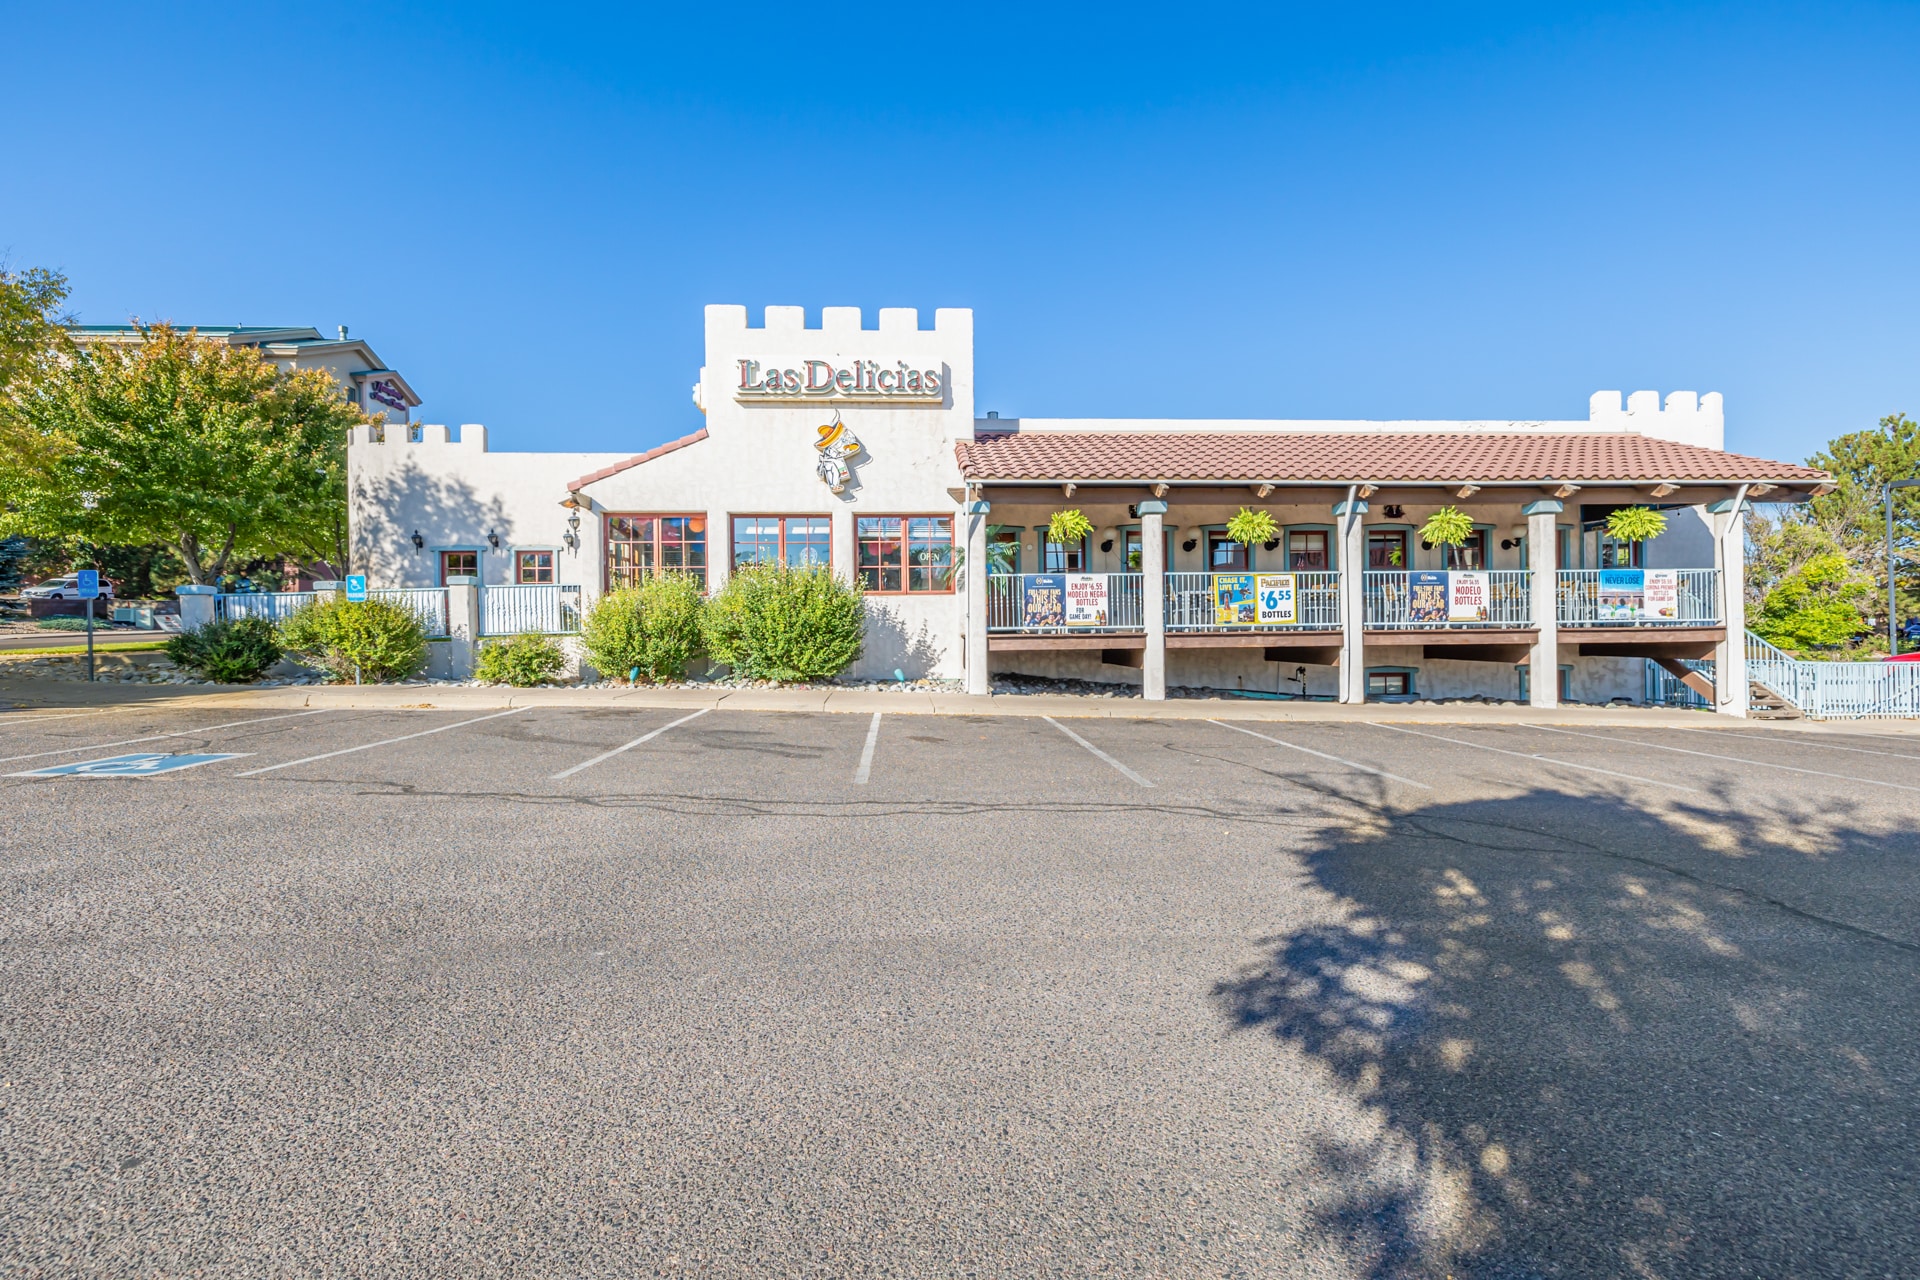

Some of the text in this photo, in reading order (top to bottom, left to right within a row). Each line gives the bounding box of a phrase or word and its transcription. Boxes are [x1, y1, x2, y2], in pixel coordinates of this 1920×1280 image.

[737, 359, 942, 391] Las Delicias
[1456, 586, 1481, 595] MODELO
[1033, 594, 1057, 604] THIS IS
[1455, 596, 1482, 605] BOTTLES
[1028, 603, 1042, 612] OUR
[1262, 610, 1292, 618] BOTTLES
